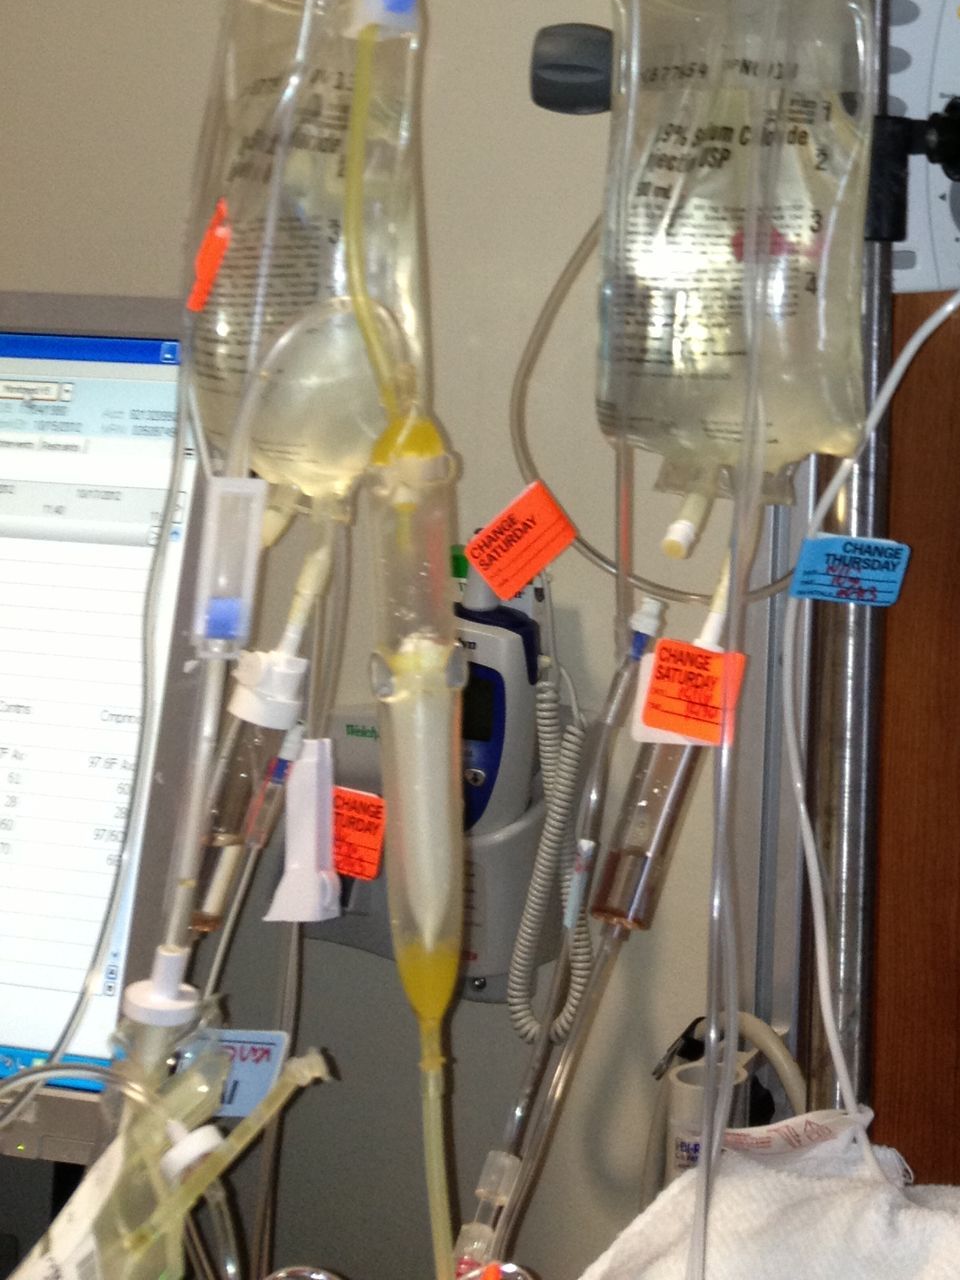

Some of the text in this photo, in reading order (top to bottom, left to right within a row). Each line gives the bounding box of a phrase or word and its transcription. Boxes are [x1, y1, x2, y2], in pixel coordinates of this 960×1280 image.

[470, 513, 519, 560] CHANGE
[478, 514, 537, 571] SATURDAY
[824, 552, 901, 573] THURSDAY
[842, 541, 905, 560] CHANGE
[659, 646, 712, 672] CHANGE
[655, 663, 719, 689] SATURDAY
